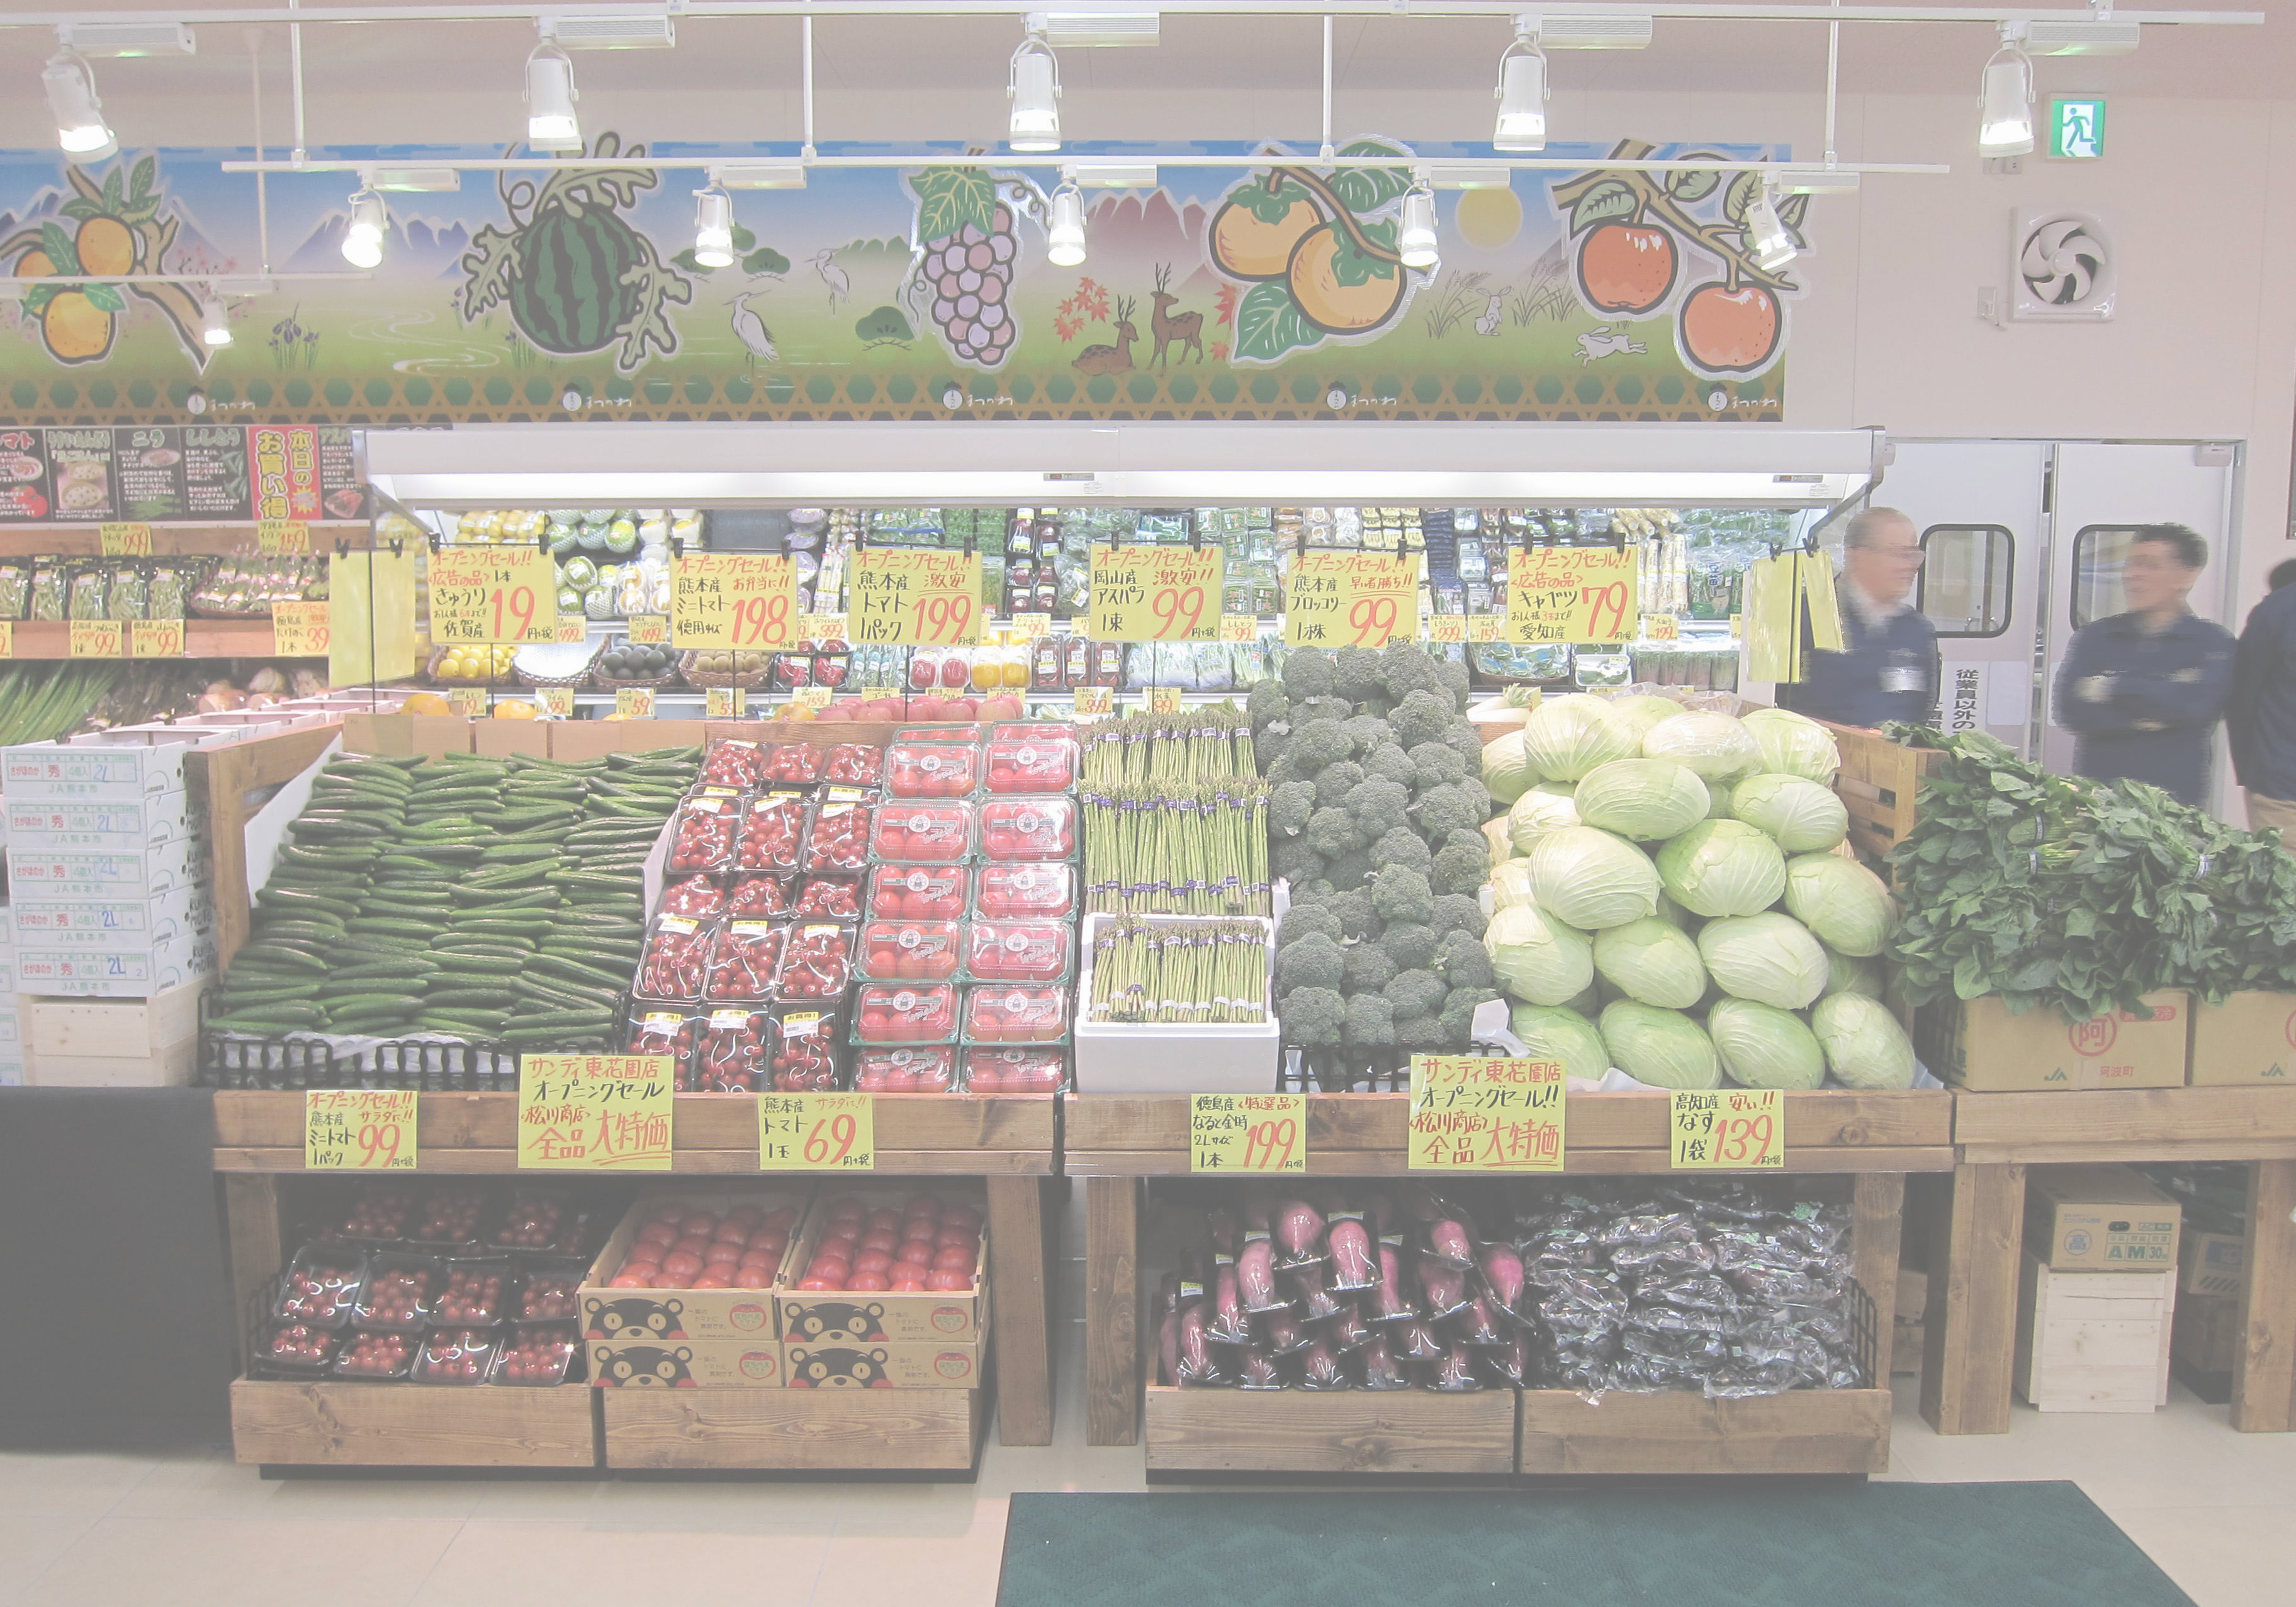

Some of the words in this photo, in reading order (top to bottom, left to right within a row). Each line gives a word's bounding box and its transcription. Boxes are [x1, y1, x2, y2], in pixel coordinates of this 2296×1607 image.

[0, 432, 35, 450] マト
[132, 429, 165, 448] ニラ
[288, 429, 313, 485] 本日の
[256, 429, 290, 521] お買い得
[279, 530, 307, 553] 159
[495, 570, 511, 582] 1本
[678, 577, 723, 594] 熊本産
[733, 575, 790, 592] お弁当に!!
[857, 570, 910, 590] 熊本産
[924, 572, 965, 588] 激安
[1094, 569, 1138, 585] 岡山産
[1152, 568, 1213, 585] 激安!!
[1294, 573, 1338, 592] 熊本産
[436, 588, 486, 606] きゅうり
[677, 595, 730, 614] ミニトマト
[864, 592, 908, 613] トマト
[1093, 586, 1144, 606] アスパラ
[1291, 593, 1346, 612] ブロッコリー
[1518, 590, 1578, 609] キャベツ
[490, 586, 535, 641] 19
[913, 595, 971, 643] 199
[1152, 586, 1204, 639] 99
[1582, 581, 1628, 638] 79
[444, 619, 485, 638] 佐賀産
[731, 595, 789, 645] 198
[860, 617, 902, 641] 1パック
[1028, 623, 1045, 636] 99
[1102, 612, 1123, 632] 1束
[1349, 597, 1397, 647] 99
[1235, 627, 1251, 641] 99
[1297, 622, 1327, 641] 1株
[1438, 626, 1461, 641] 299
[1480, 626, 1499, 641] 159
[1520, 623, 1567, 641] 愛知産
[95, 633, 115, 656] 99
[157, 631, 179, 656] 99
[48, 765, 60, 777] 秀
[94, 764, 110, 782] 2L
[52, 815, 64, 828] 秀
[96, 815, 114, 832] 2L
[53, 865, 65, 877] 秀
[101, 857, 117, 875] 2L
[57, 914, 68, 926] 秀
[102, 911, 118, 927] 2L
[60, 963, 72, 976] 秀
[108, 957, 125, 974] 2L
[2078, 1018, 2107, 1047] 阿
[527, 1056, 660, 1080] サンディ東花園店
[1421, 1058, 1561, 1085] サンディ東花園店
[2100, 1066, 2134, 1078] 阿波町
[533, 1079, 665, 1102] オープニングセール
[764, 1096, 804, 1114] 熊本産
[1196, 1095, 1235, 1112] 徳島産
[1675, 1093, 1720, 1112] 高知産
[1729, 1091, 1775, 1112] 安い!!
[310, 1110, 344, 1127] 熊本産
[359, 1109, 414, 1123] サラダに!!
[765, 1115, 808, 1135] トマト
[1193, 1114, 1247, 1131] なると金時
[1677, 1111, 1716, 1135] なす
[309, 1127, 356, 1146] ミニトマト
[588, 1109, 671, 1155] 大特価
[804, 1114, 857, 1164] 69
[1478, 1116, 1560, 1163] 大特価
[1713, 1114, 1773, 1165] 139
[358, 1124, 400, 1168] 99
[527, 1127, 586, 1159] 全品
[769, 1142, 789, 1159] 1玉
[1244, 1118, 1297, 1171] 199
[1422, 1135, 1474, 1164] 全品
[1680, 1138, 1708, 1163] 1袋
[314, 1148, 343, 1166] 1パック
[1201, 1151, 1224, 1168] 1本
[2108, 1246, 2123, 1259] A
[2127, 1246, 2145, 1259] M
